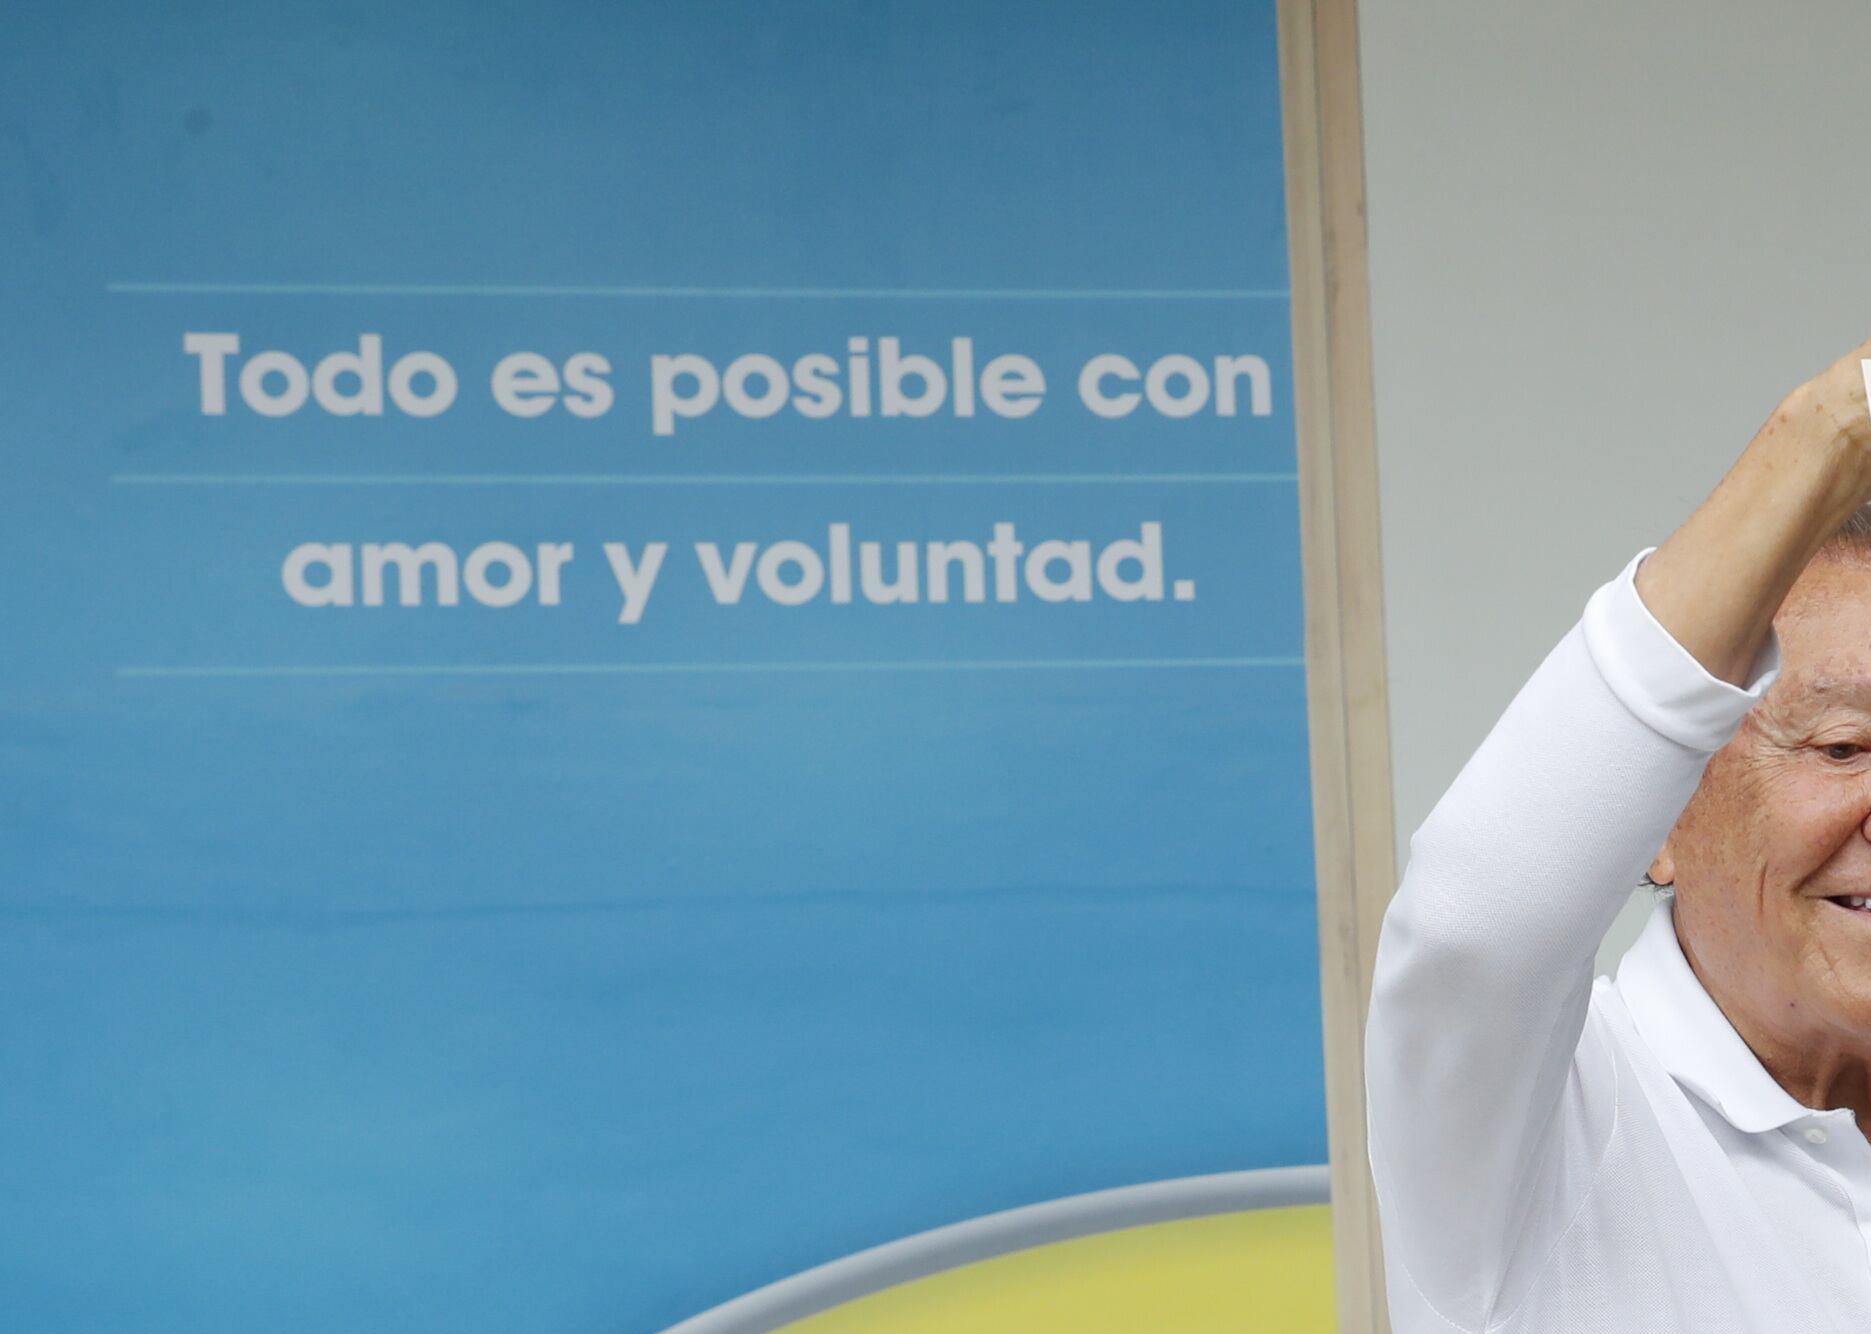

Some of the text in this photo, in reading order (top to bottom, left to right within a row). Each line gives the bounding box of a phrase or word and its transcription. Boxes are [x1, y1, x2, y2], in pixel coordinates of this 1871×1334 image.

[184, 333, 1272, 435] Todo es posible con
[281, 521, 1195, 624] amor y voluntad.
